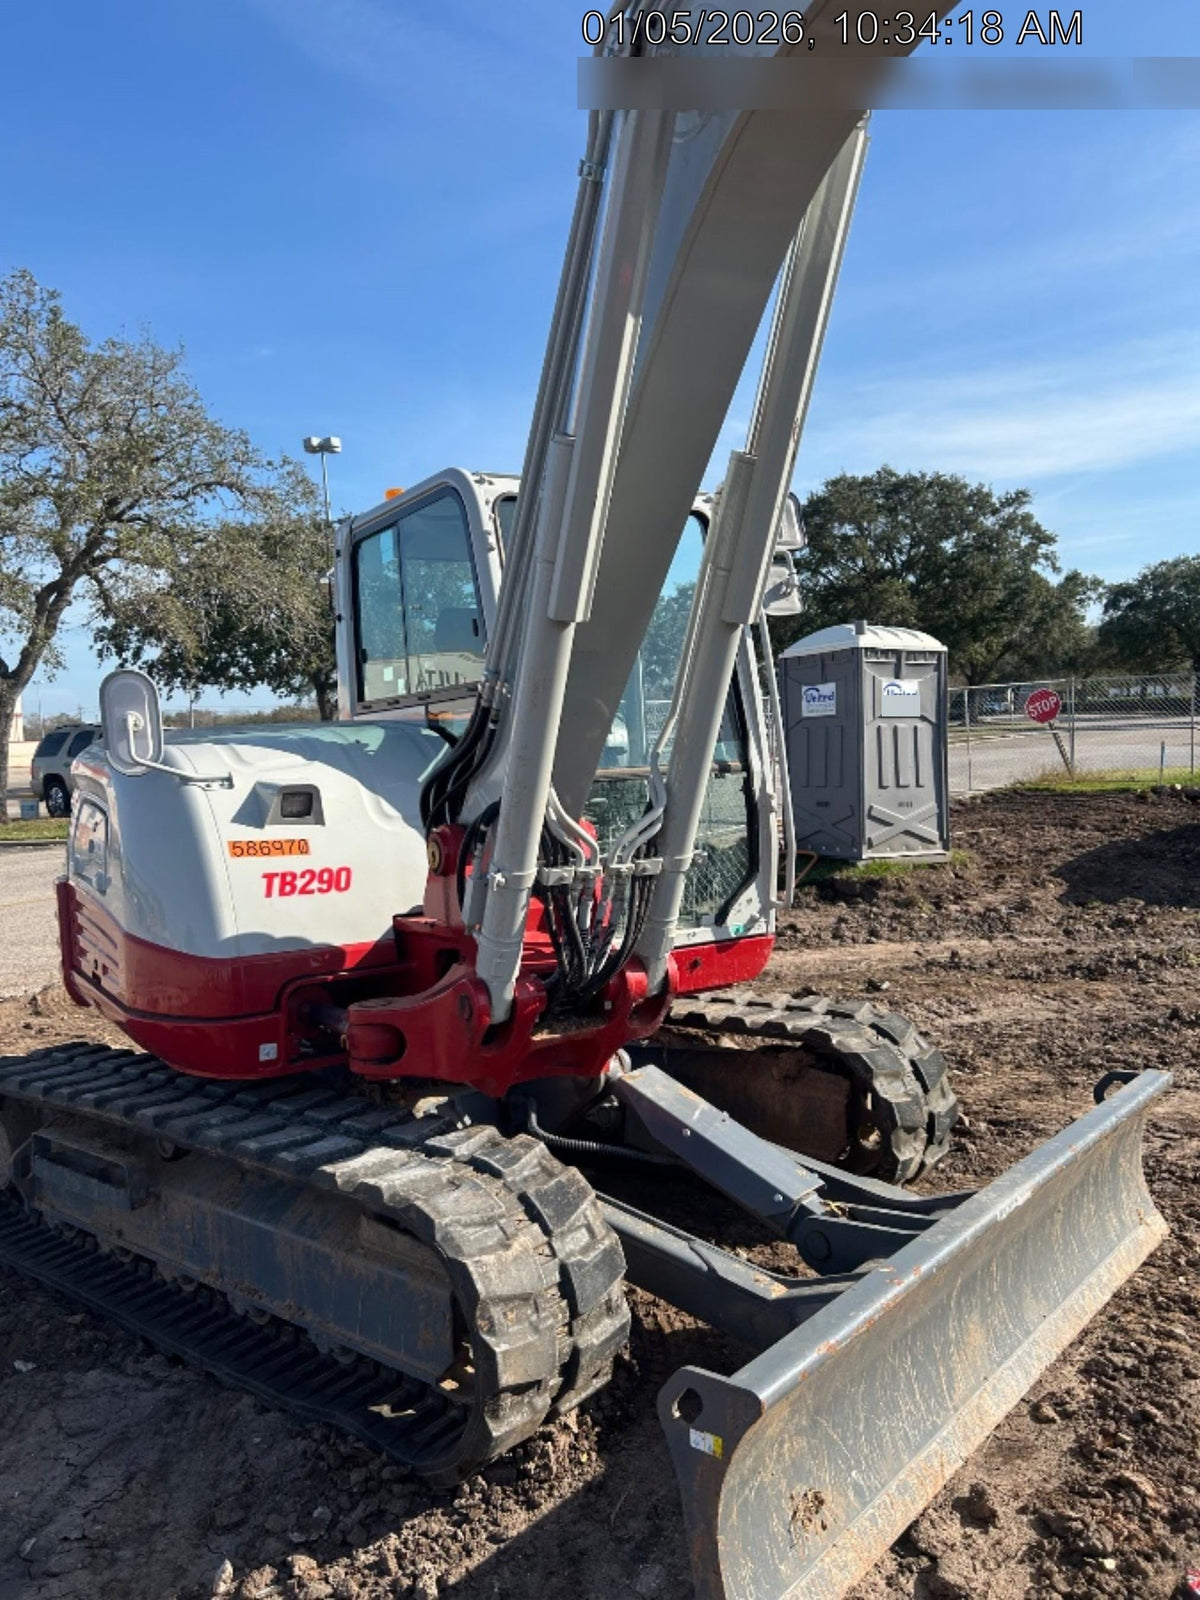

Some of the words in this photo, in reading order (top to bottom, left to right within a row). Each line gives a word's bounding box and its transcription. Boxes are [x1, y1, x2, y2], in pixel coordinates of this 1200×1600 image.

[1029, 696, 1057, 717] STOP
[233, 839, 309, 857] 586970
[262, 867, 352, 898] TB290
